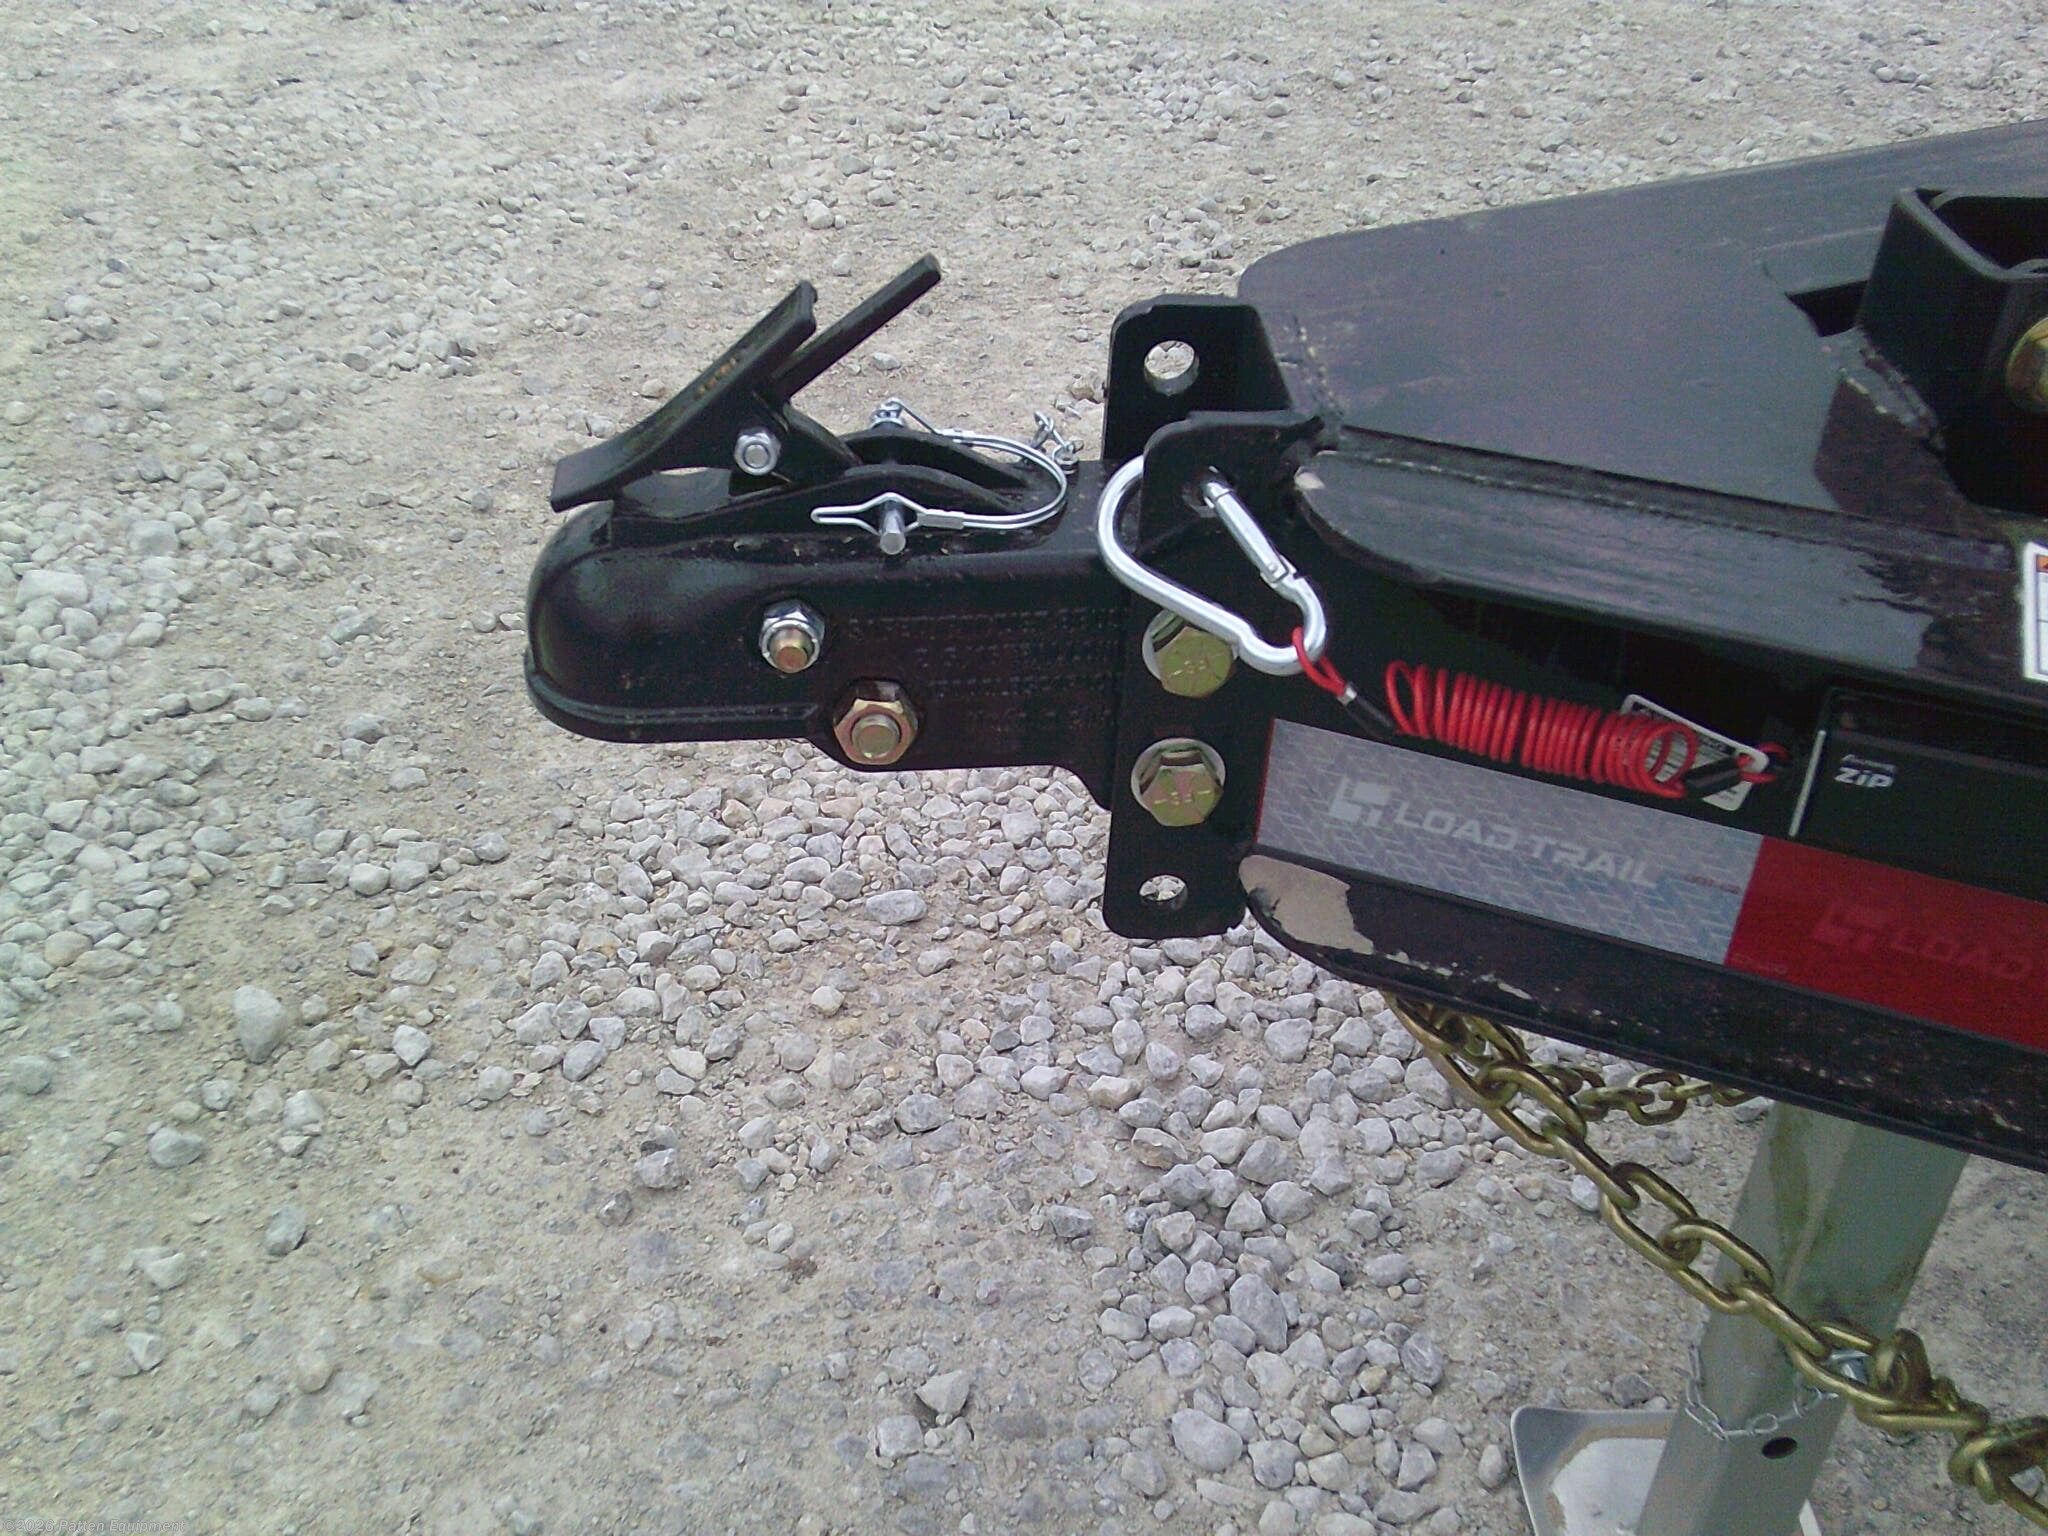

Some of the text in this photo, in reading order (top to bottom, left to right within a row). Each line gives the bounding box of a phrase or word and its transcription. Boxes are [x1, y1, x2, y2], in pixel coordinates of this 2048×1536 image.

[1397, 803, 1518, 851] LOAD
[1528, 836, 1657, 889] TRAIL
[1892, 926, 2032, 982] LOAD
